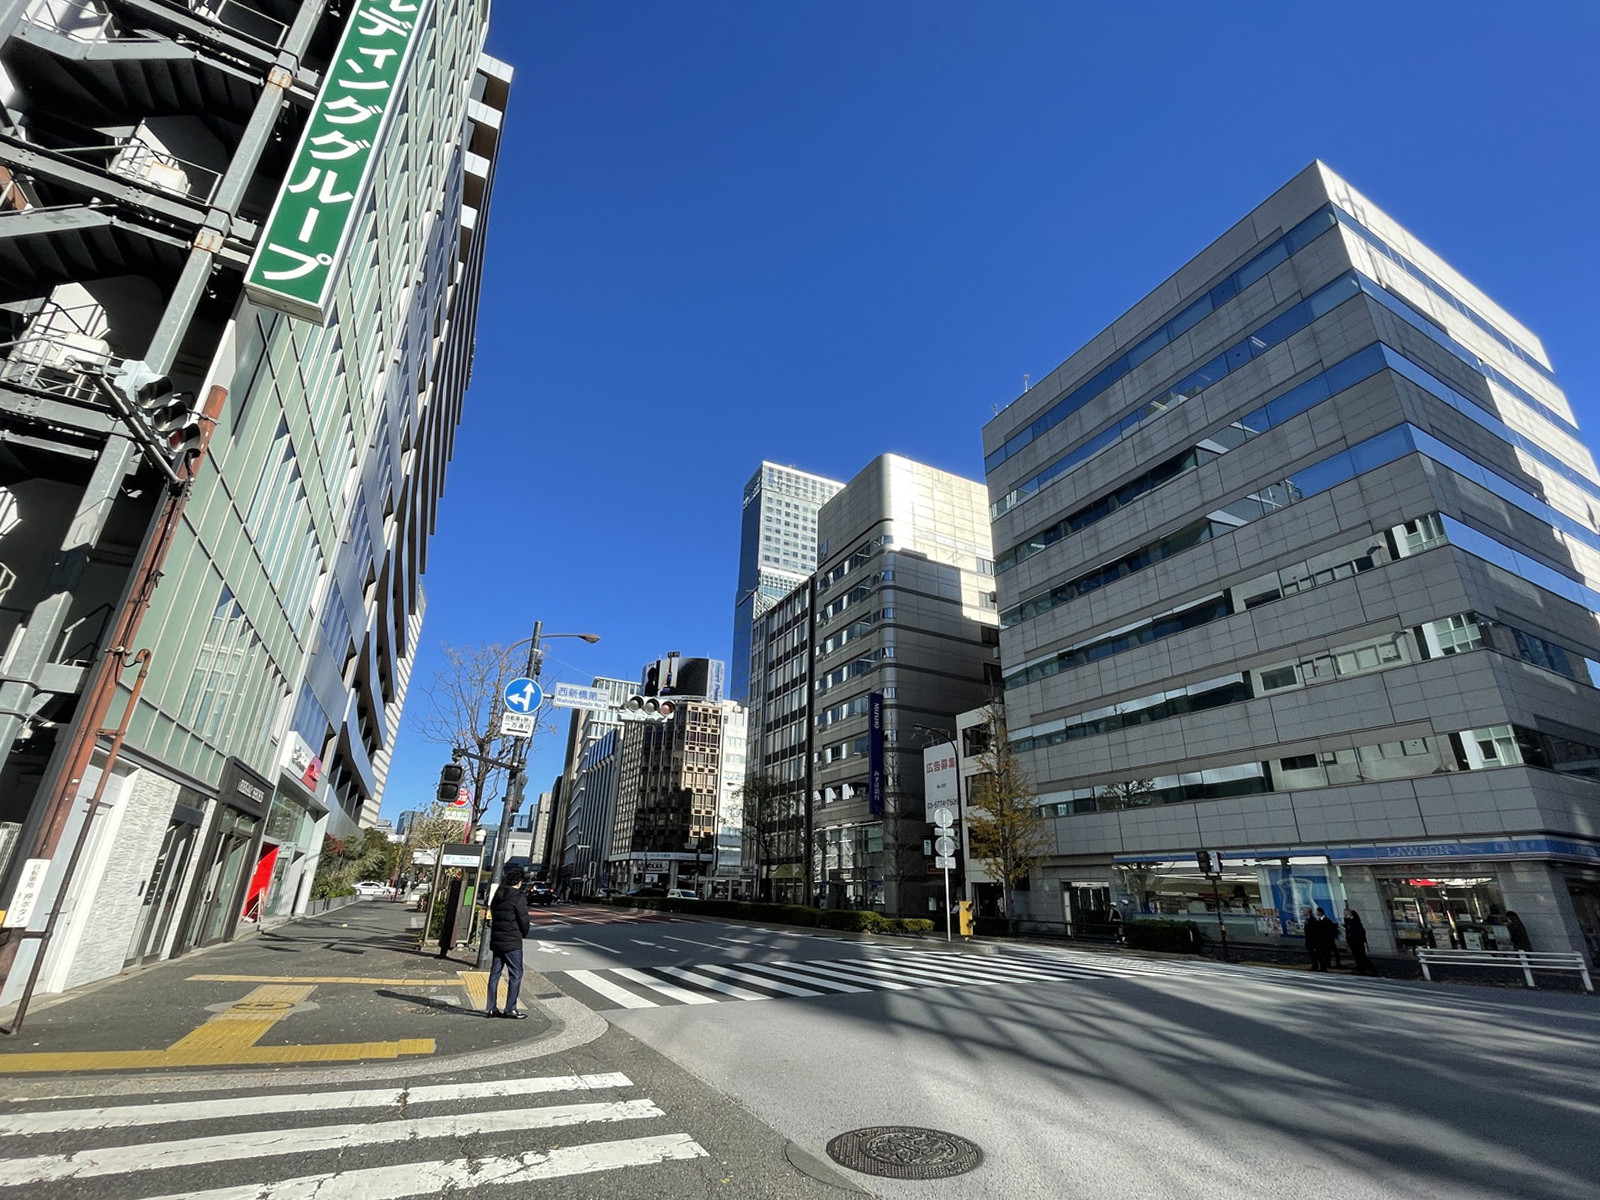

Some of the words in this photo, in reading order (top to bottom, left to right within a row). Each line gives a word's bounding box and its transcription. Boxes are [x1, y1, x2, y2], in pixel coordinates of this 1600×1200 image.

[558, 686, 607, 702] 西新橋第二
[504, 722, 530, 731] 一方通行
[926, 757, 955, 773] 広告募集
[1386, 845, 1451, 857] LAWSON
